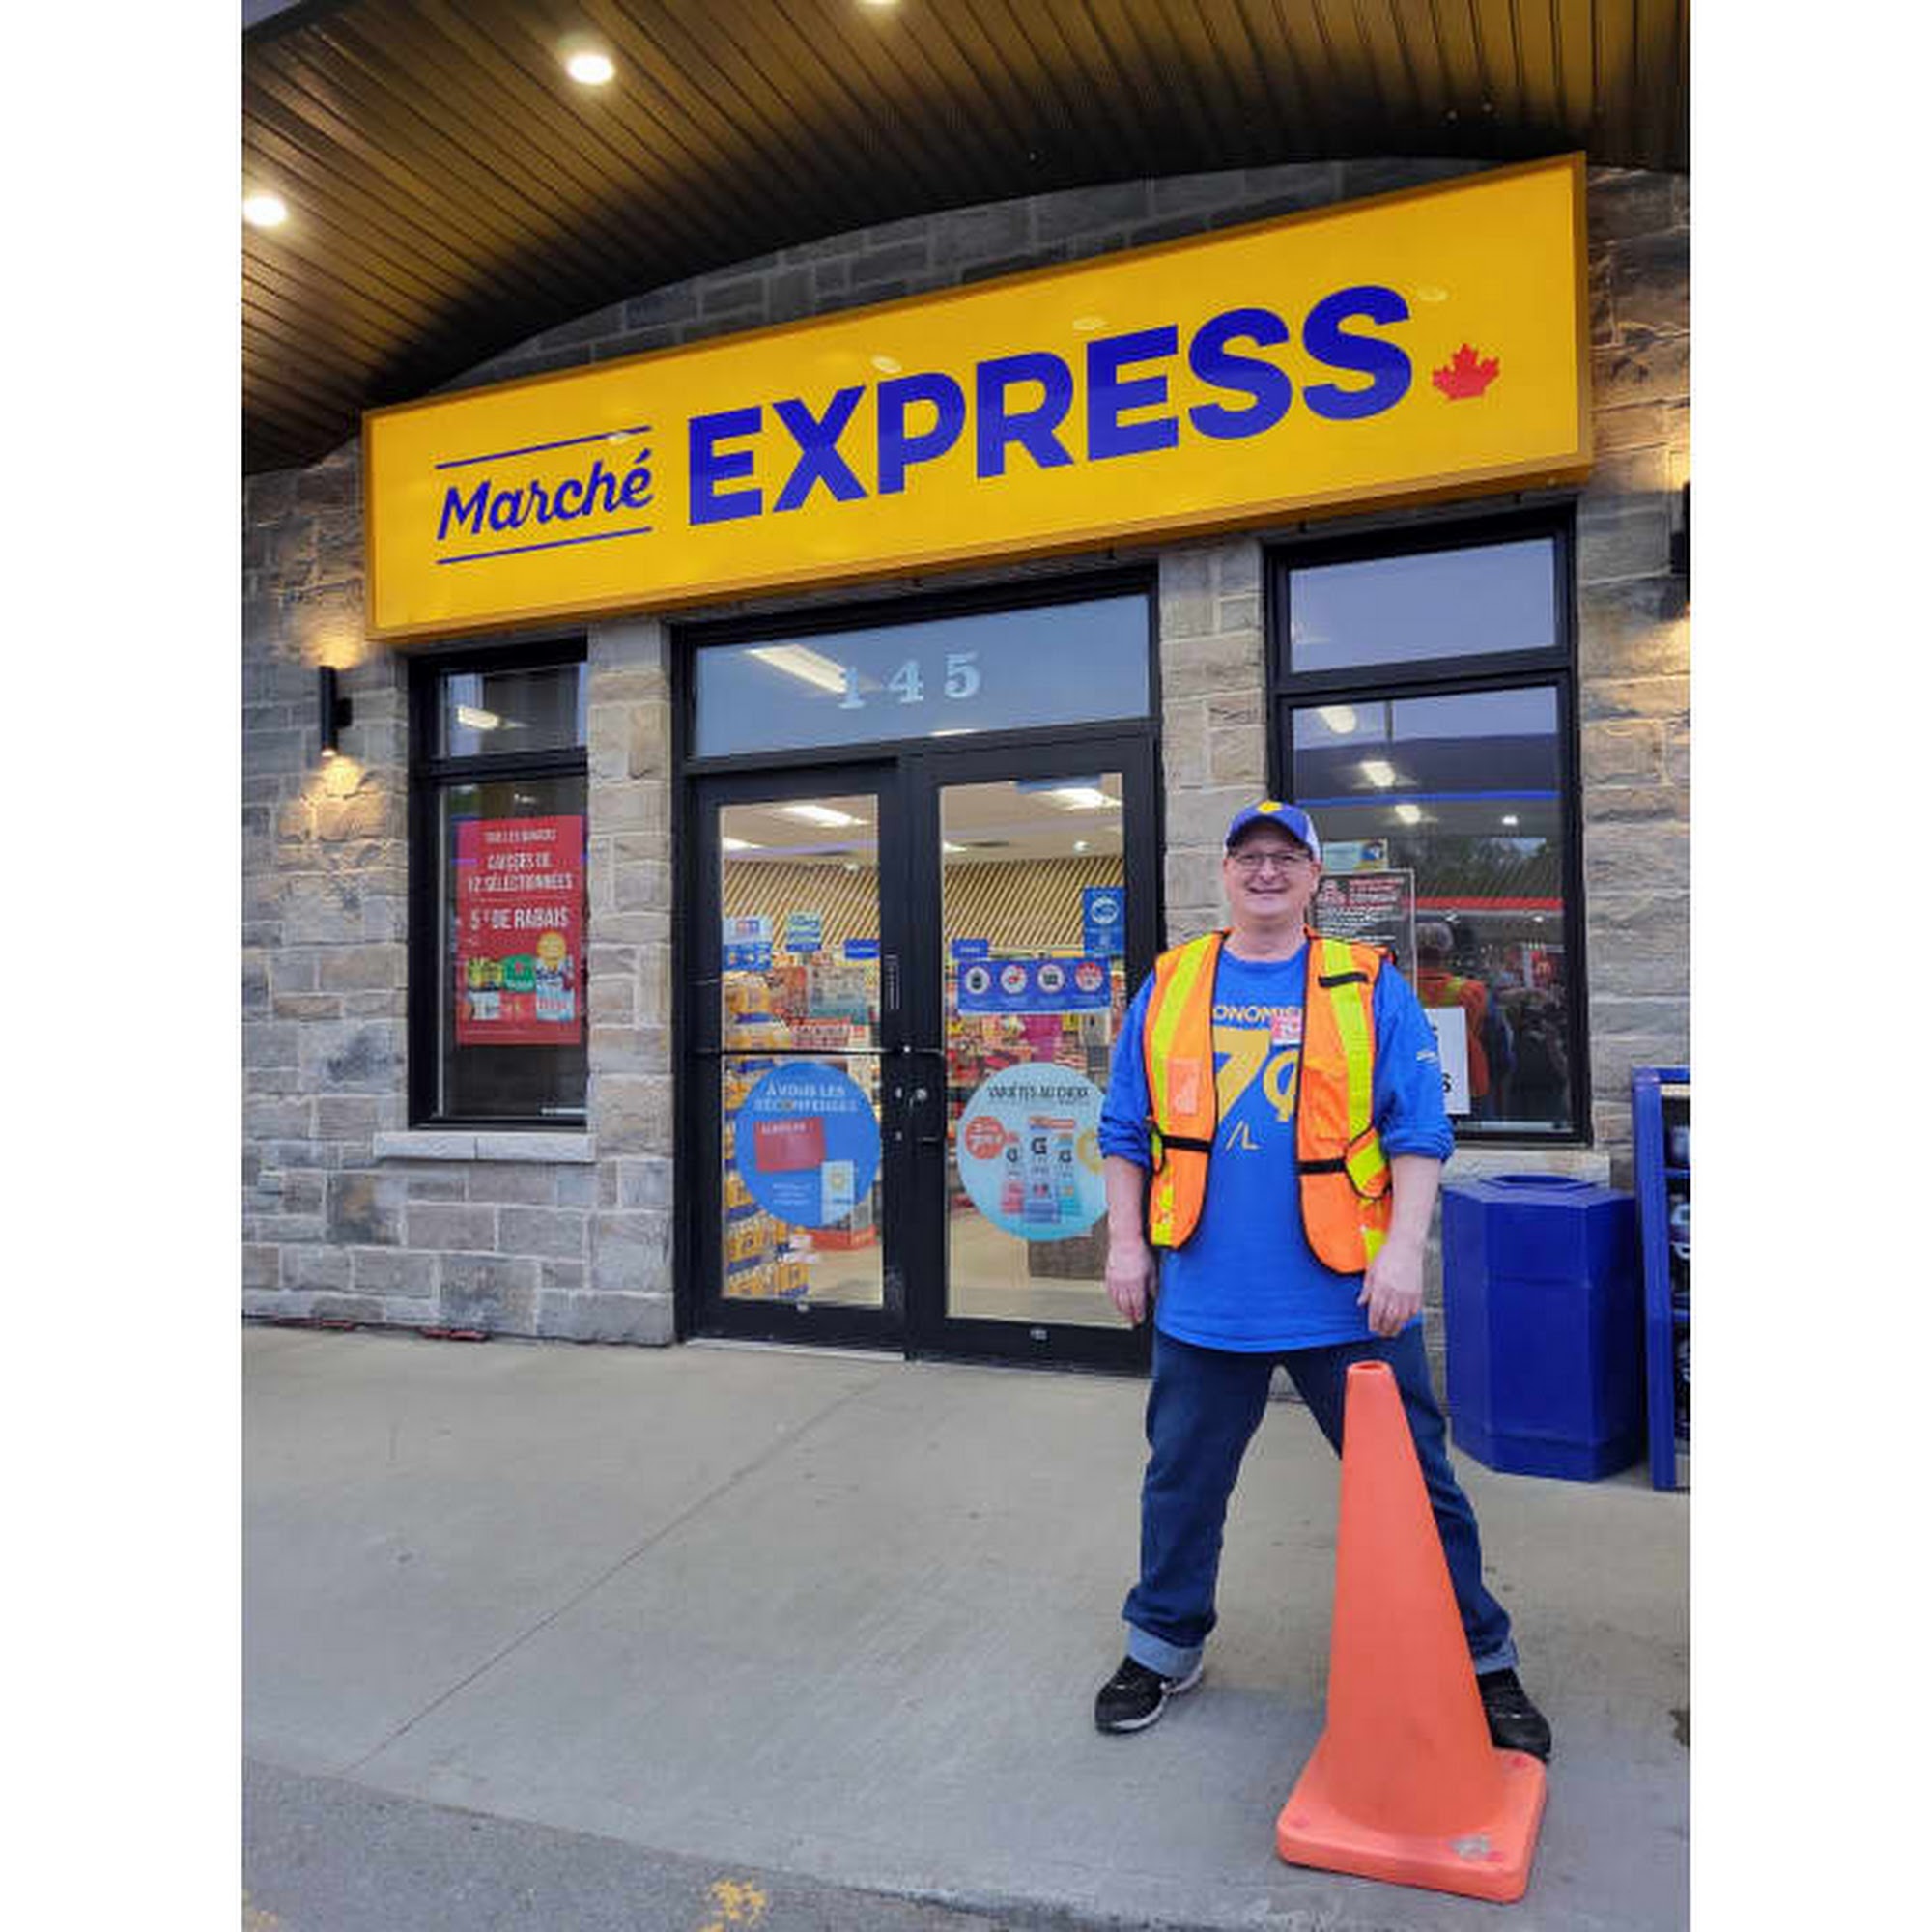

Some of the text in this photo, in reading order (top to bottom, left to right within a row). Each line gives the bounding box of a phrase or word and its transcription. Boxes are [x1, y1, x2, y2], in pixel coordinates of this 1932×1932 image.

[437, 285, 1412, 540] Marché EXPRESS
[515, 906, 570, 929] RABAIS
[1031, 1137, 1047, 1155] G
